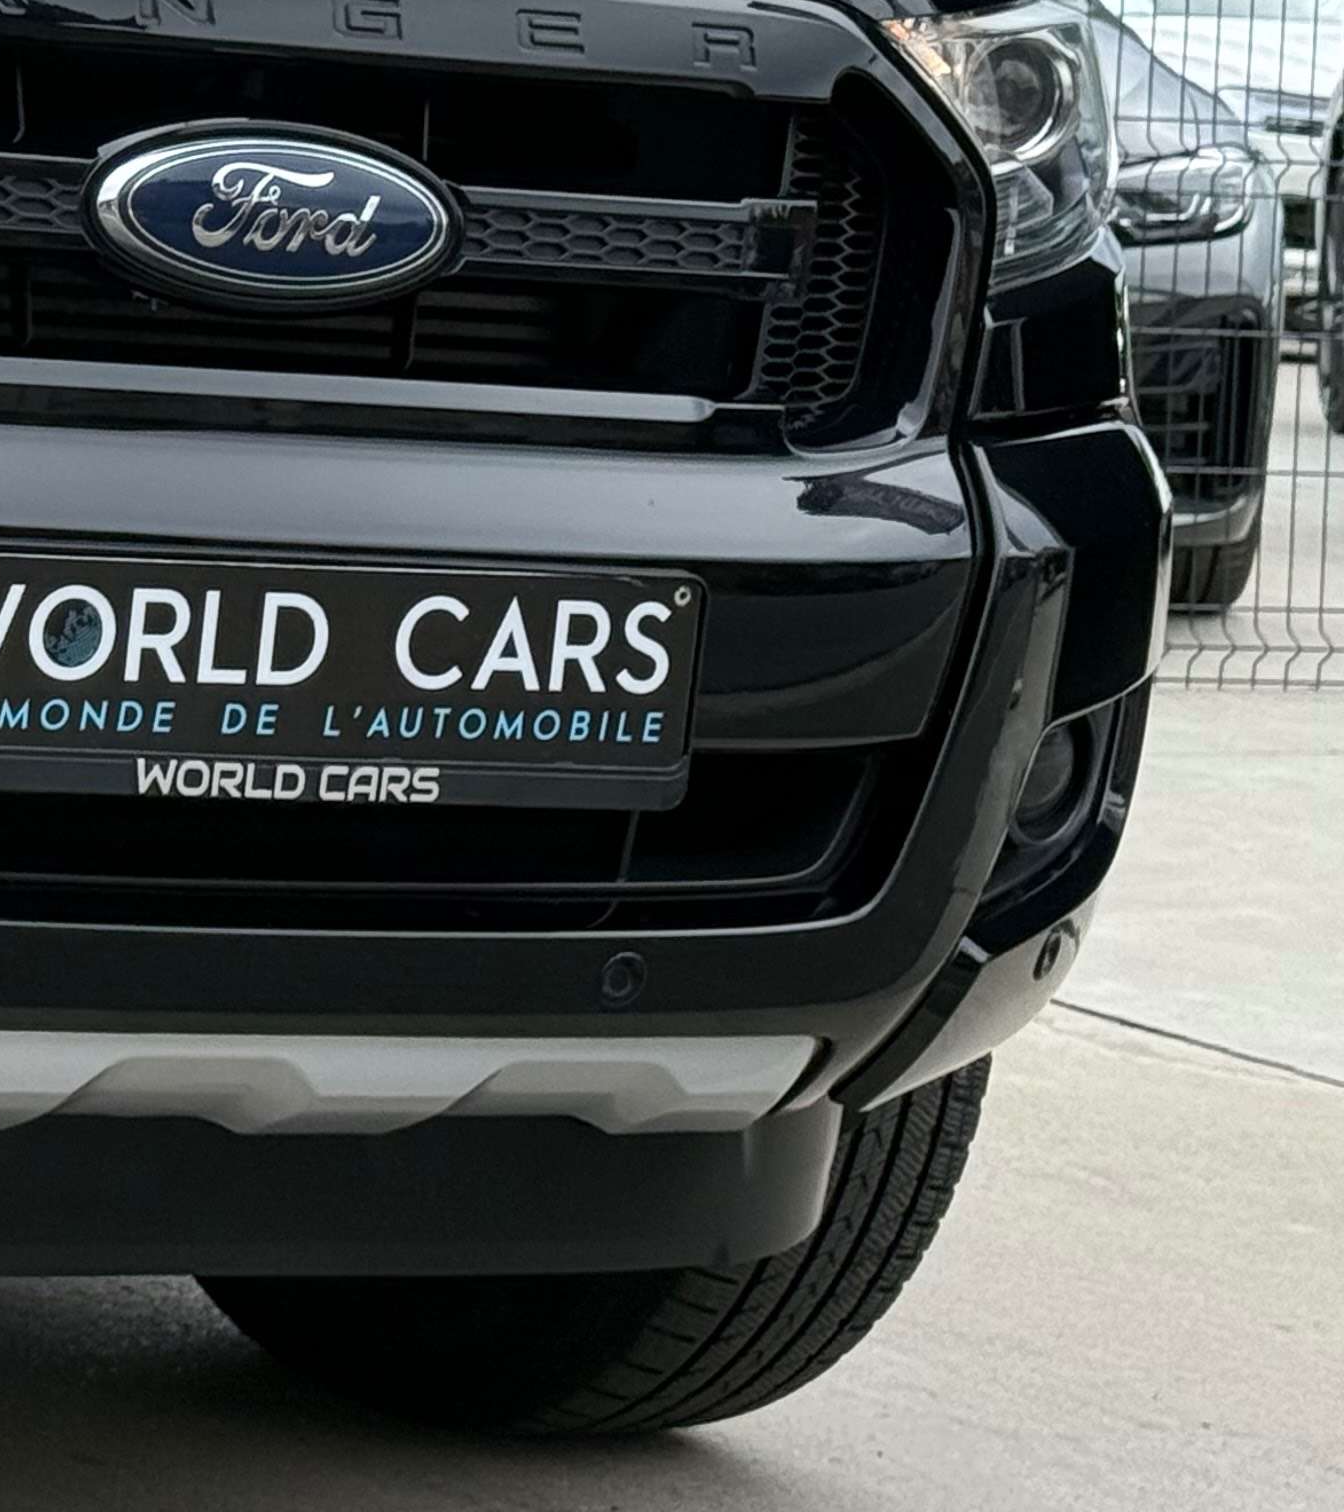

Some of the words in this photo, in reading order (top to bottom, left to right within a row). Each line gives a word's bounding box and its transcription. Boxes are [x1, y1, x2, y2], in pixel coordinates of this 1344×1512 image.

[192, 159, 381, 258] Ford
[393, 594, 675, 696] CARS
[220, 701, 280, 737] DE
[322, 703, 667, 745] L'AUTOMOBILE
[135, 757, 308, 801] WORLD
[317, 762, 442, 805] CARS
